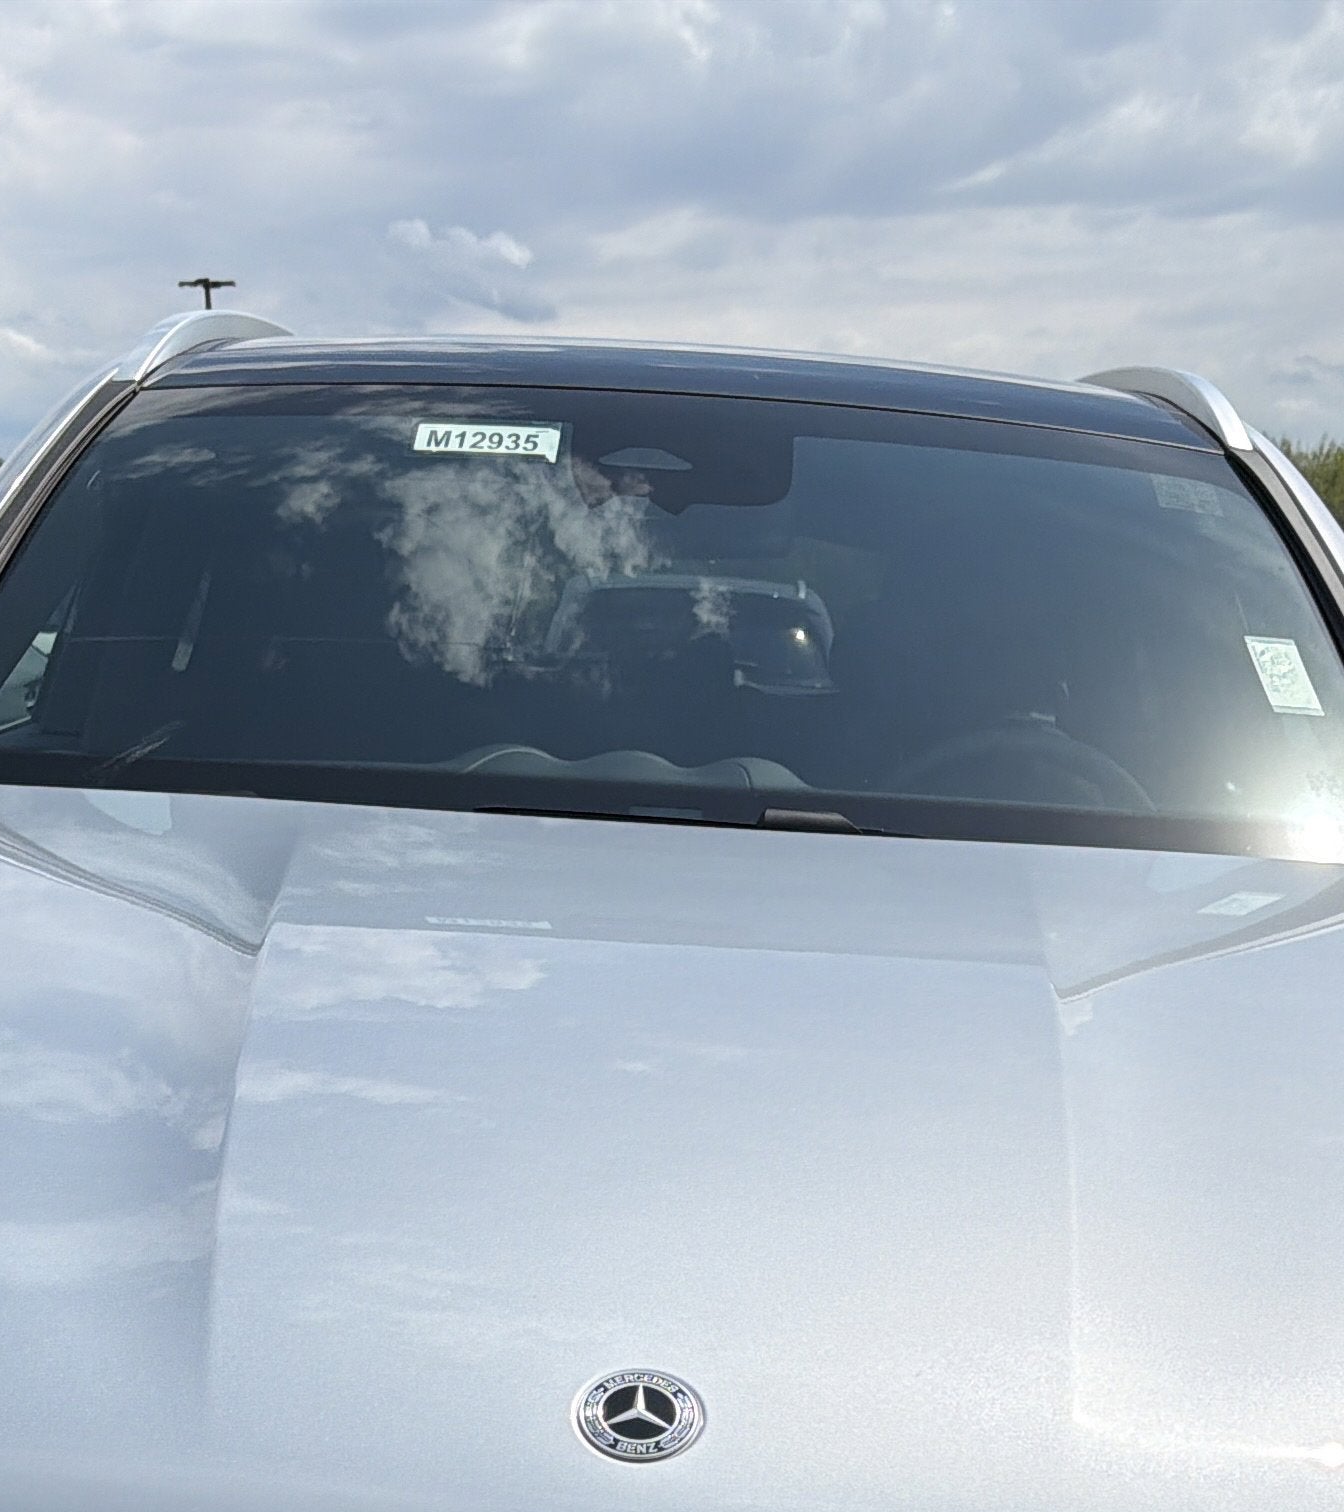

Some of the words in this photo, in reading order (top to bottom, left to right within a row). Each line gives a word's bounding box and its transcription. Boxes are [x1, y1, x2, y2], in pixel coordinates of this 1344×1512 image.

[425, 429, 540, 452] M12935
[603, 1373, 679, 1393] MERCEDES
[615, 1440, 659, 1454] BENZ
